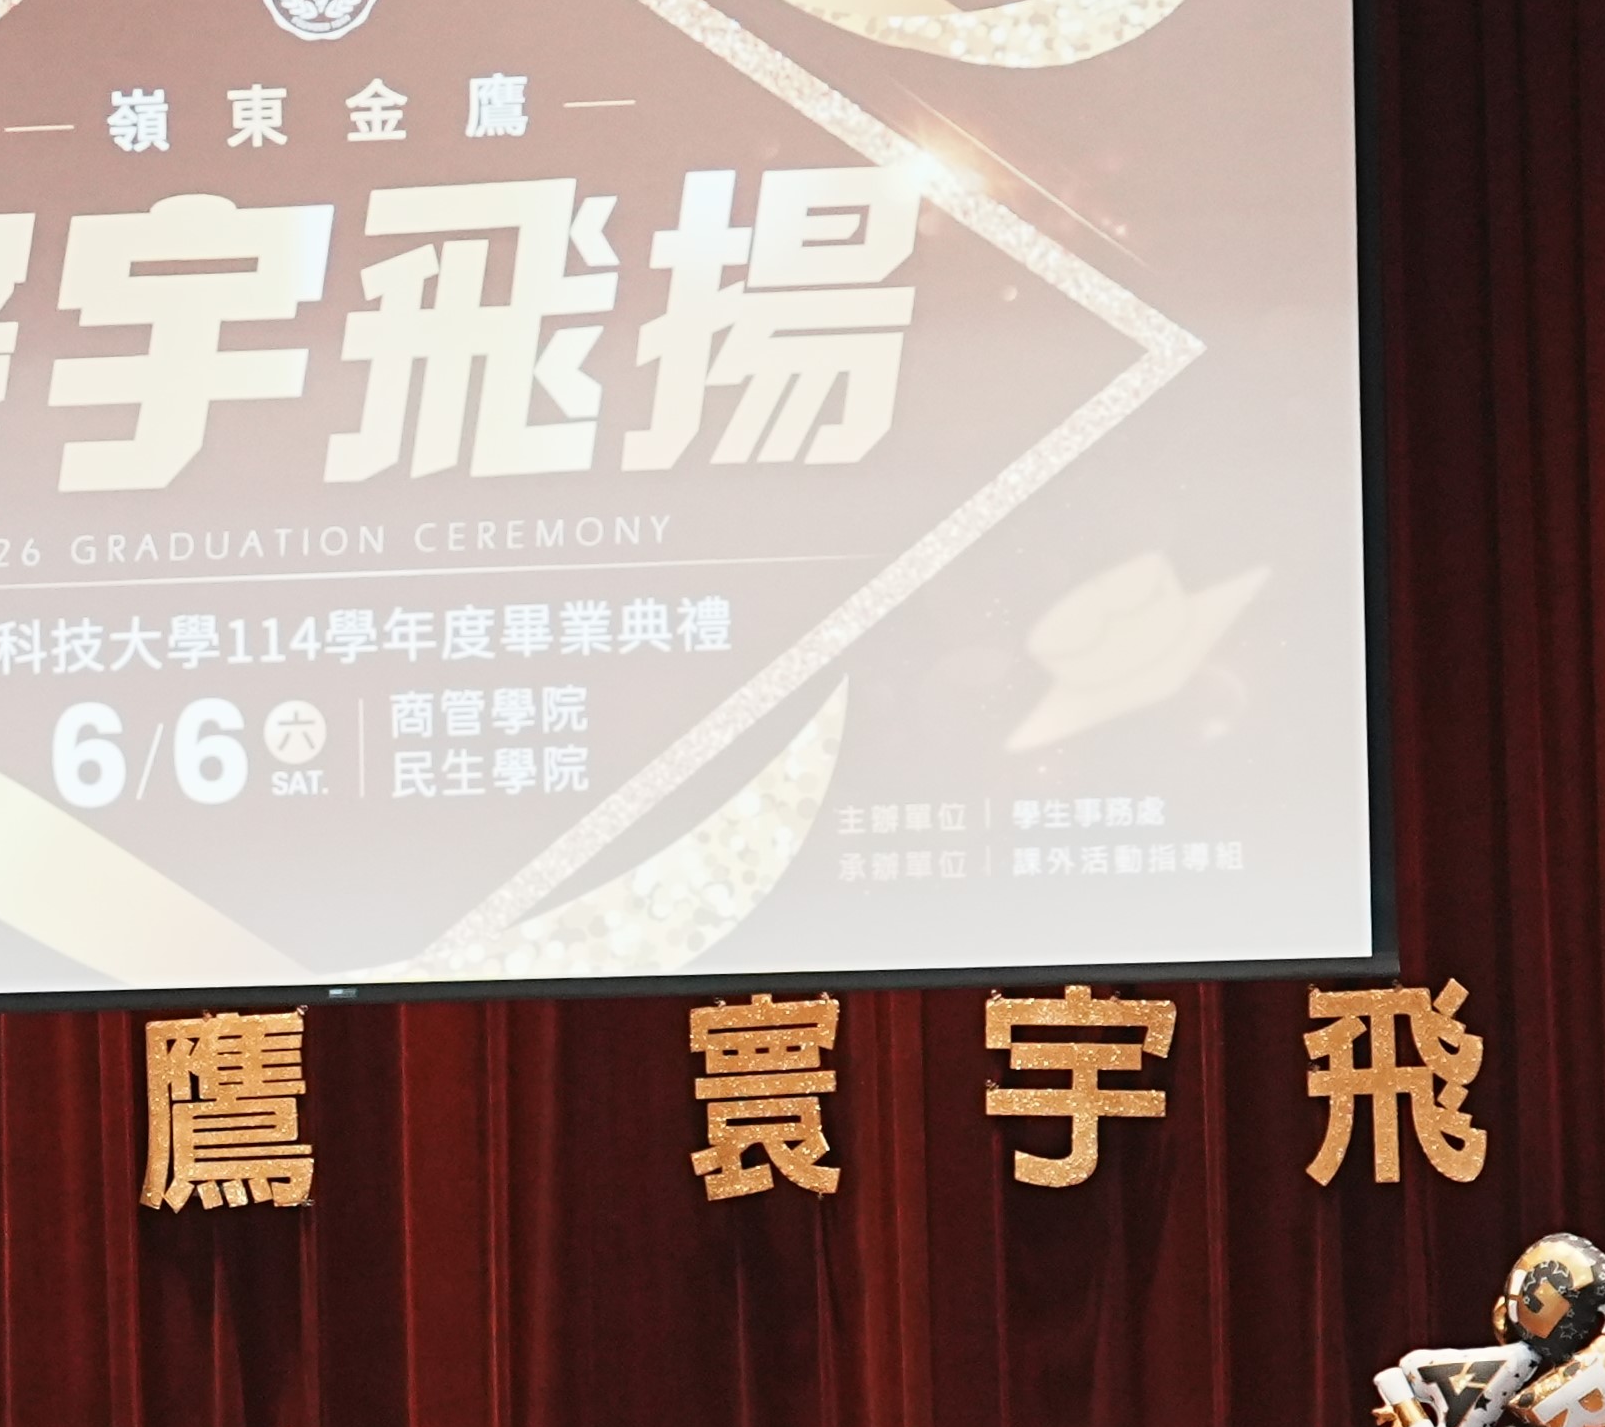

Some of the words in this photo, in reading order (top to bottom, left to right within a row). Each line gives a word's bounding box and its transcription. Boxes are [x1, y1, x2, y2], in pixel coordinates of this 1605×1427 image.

[107, 73, 529, 152] 嶺東金鷹
[70, 525, 385, 565] GRADUATION
[414, 515, 673, 553] CEREMONY
[390, 684, 588, 739] 商管學院
[52, 698, 248, 808] 6/6
[392, 744, 589, 798] 民生學院
[271, 770, 329, 796] SAT.
